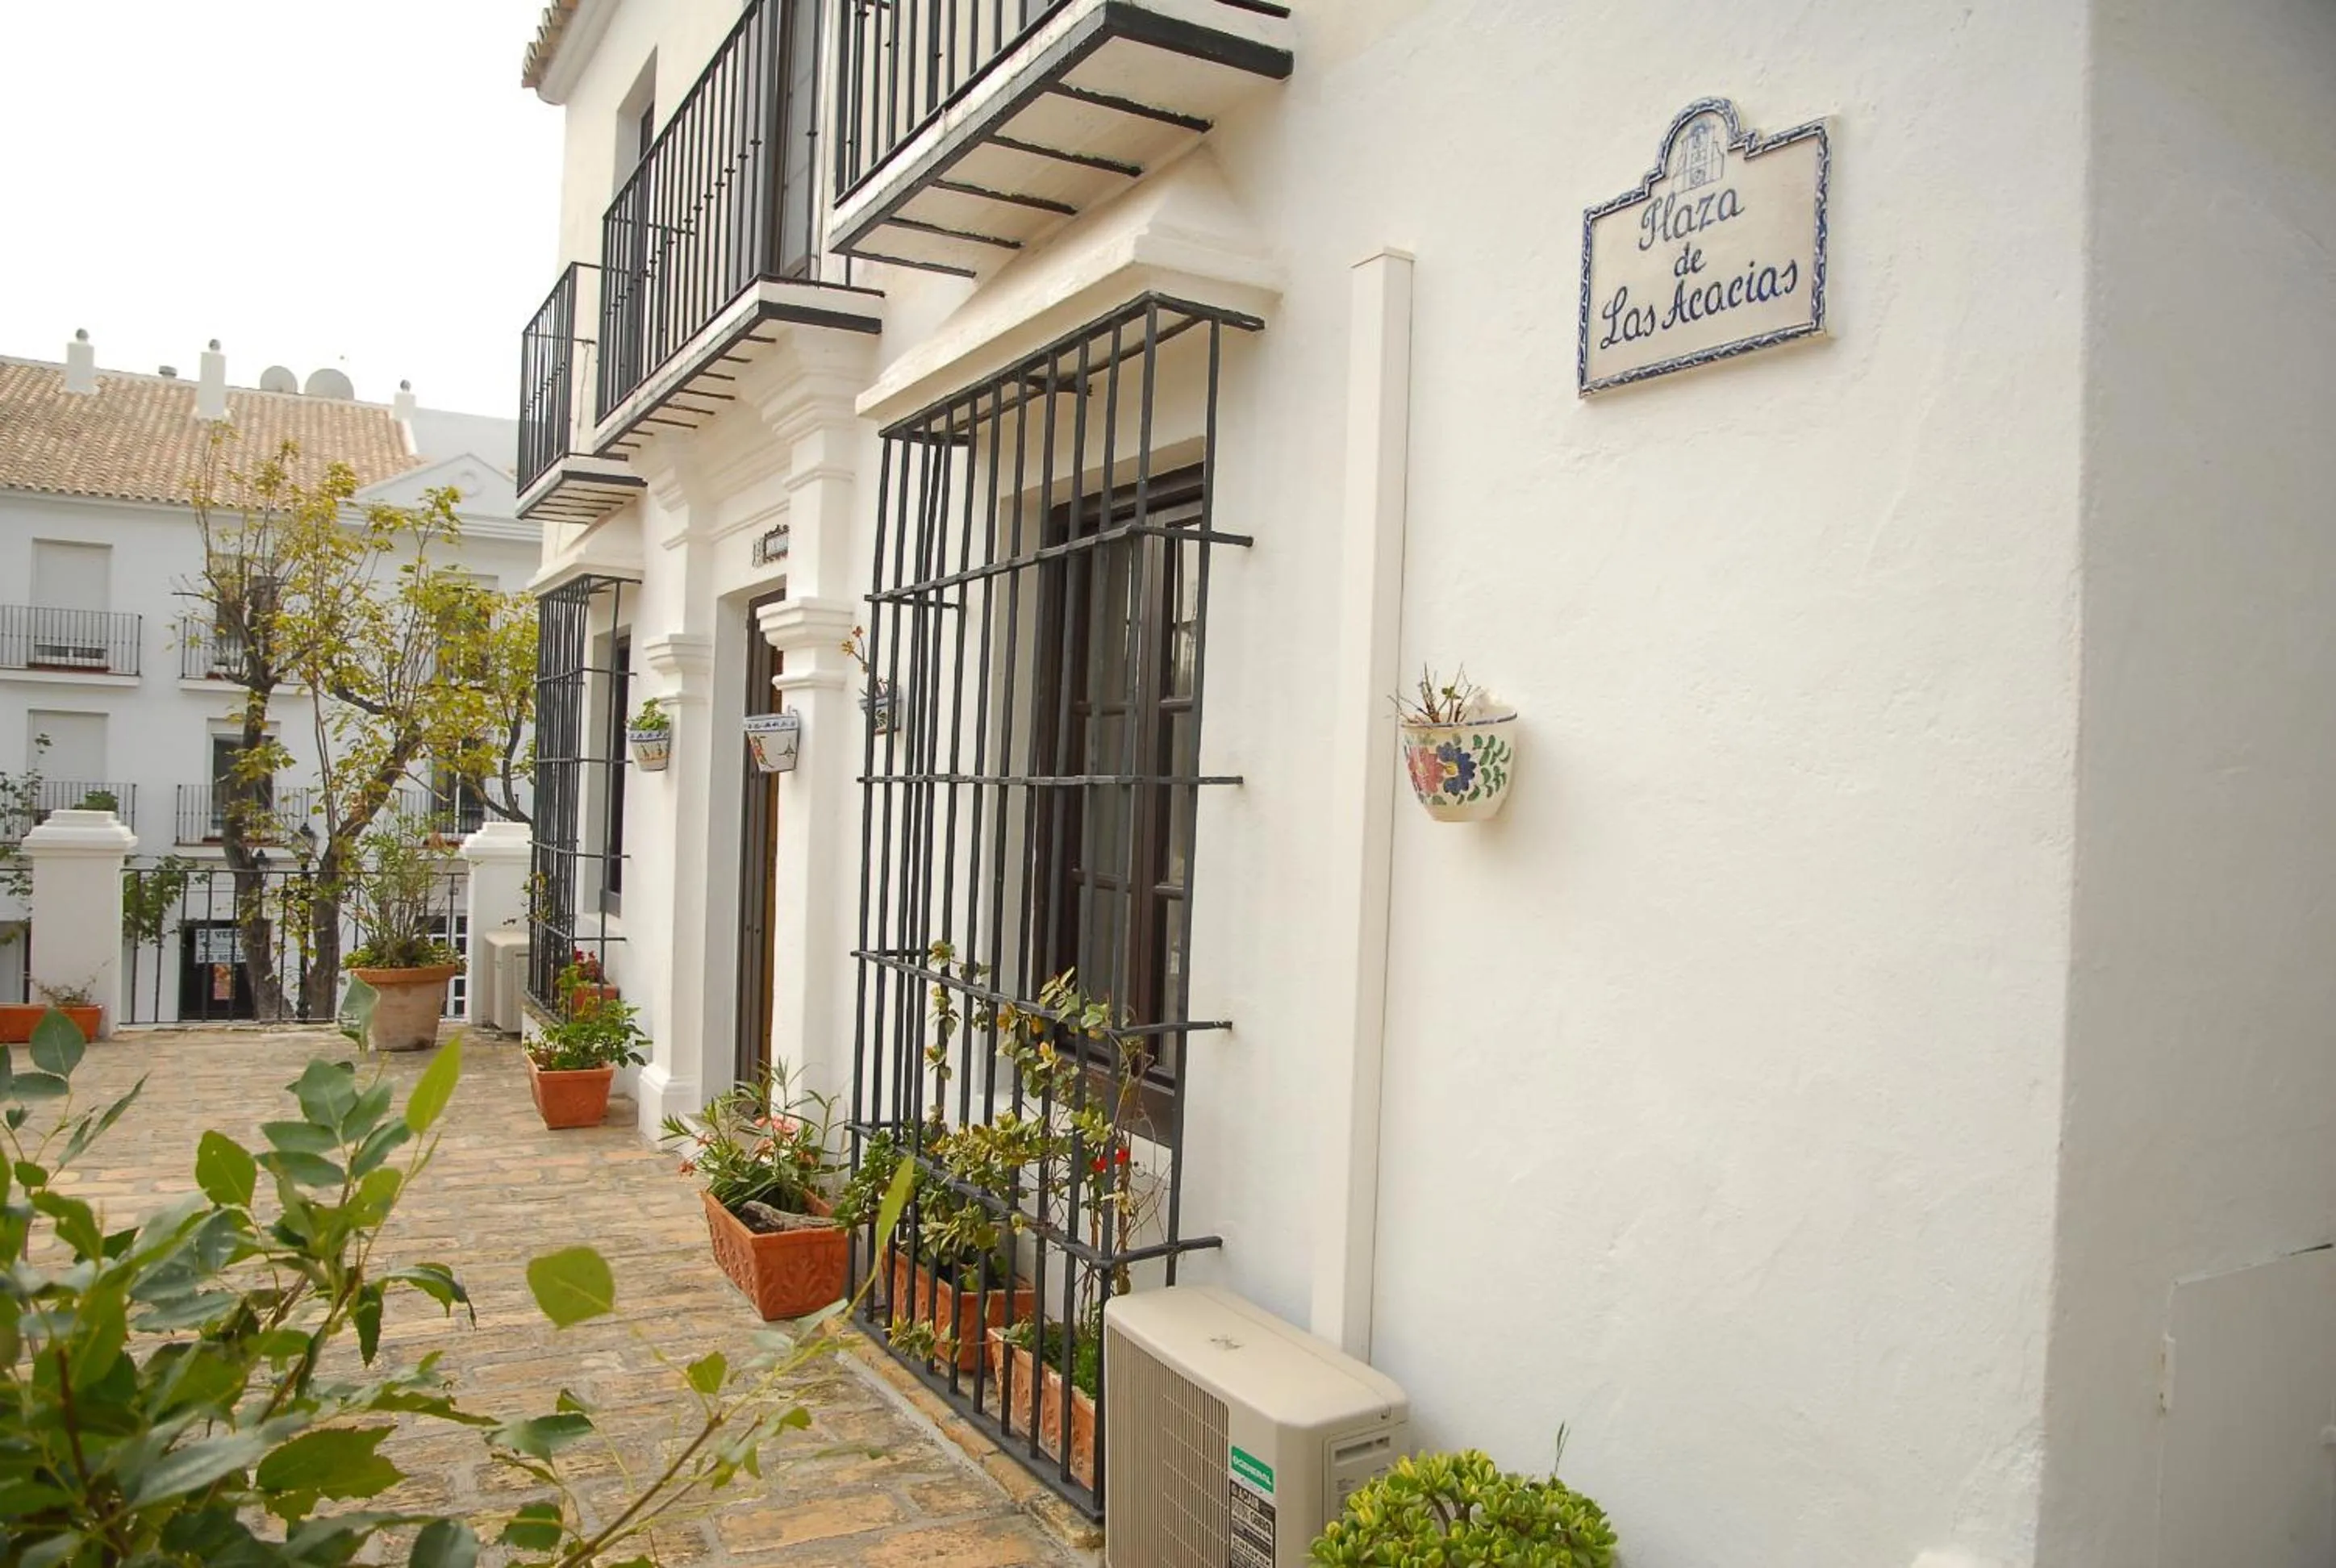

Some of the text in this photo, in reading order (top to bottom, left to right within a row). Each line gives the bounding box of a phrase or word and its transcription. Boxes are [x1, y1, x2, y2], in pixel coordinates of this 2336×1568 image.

[1638, 189, 1745, 252] Plaza
[1674, 242, 1707, 277] de
[1600, 259, 1799, 350] Las Acacias
